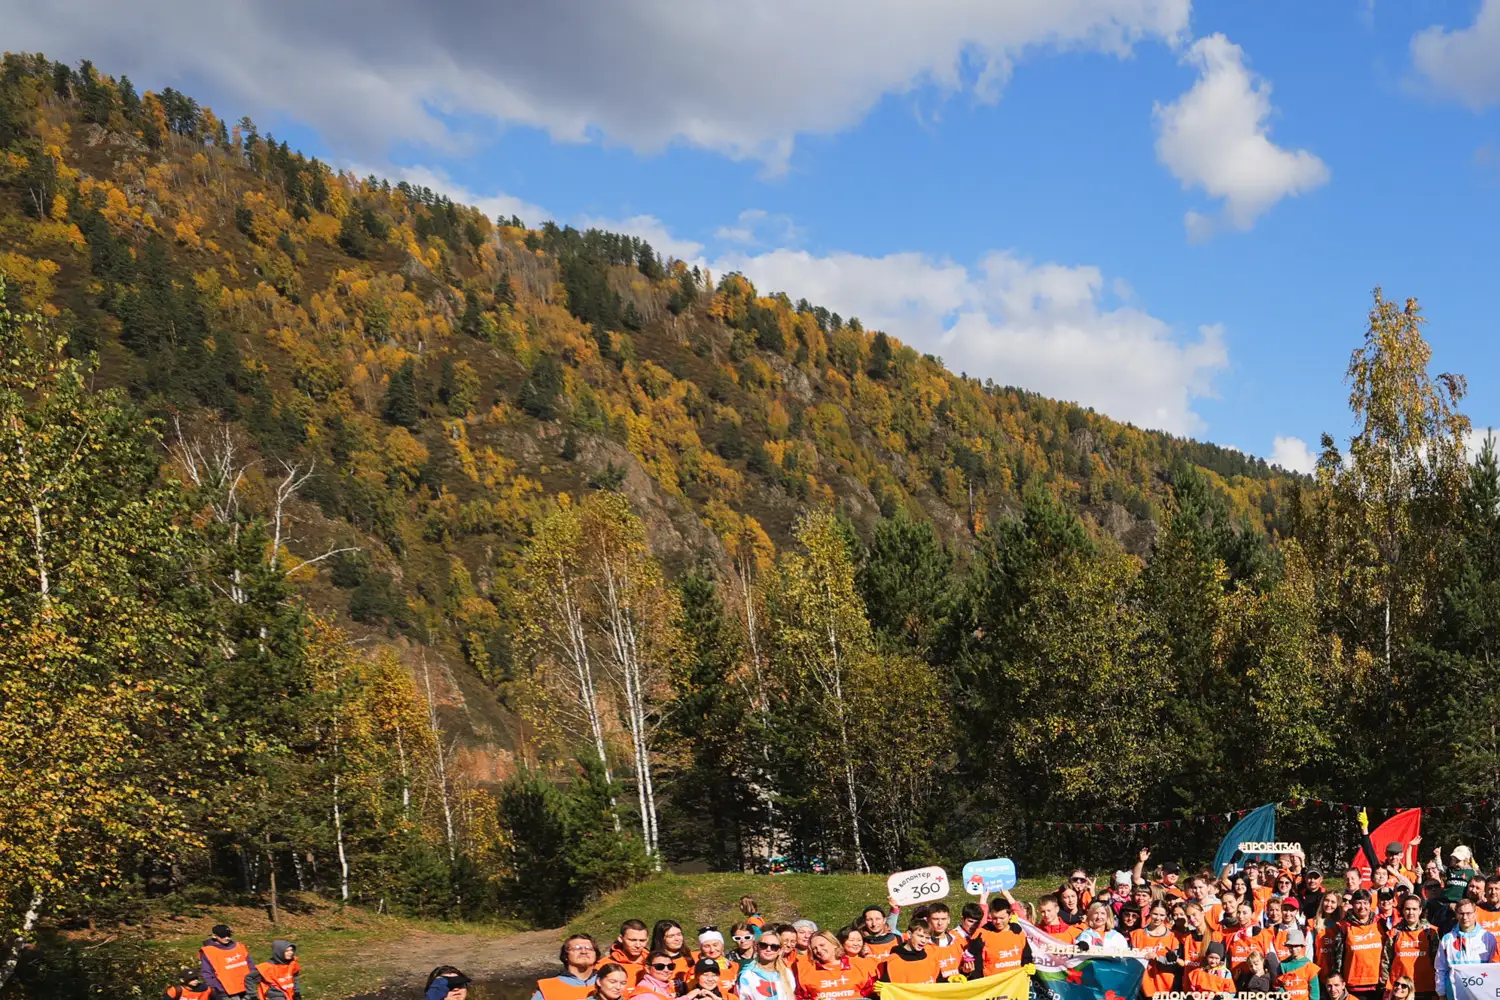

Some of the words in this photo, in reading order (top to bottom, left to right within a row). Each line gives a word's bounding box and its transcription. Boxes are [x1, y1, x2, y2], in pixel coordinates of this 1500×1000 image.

[1238, 842, 1301, 853] #ПРОЕКТ360
[1354, 930, 1375, 942] ЭН+
[1401, 936, 1422, 949] ЭН+
[999, 944, 1020, 959] ЭН+
[820, 975, 850, 989] ЭН+
